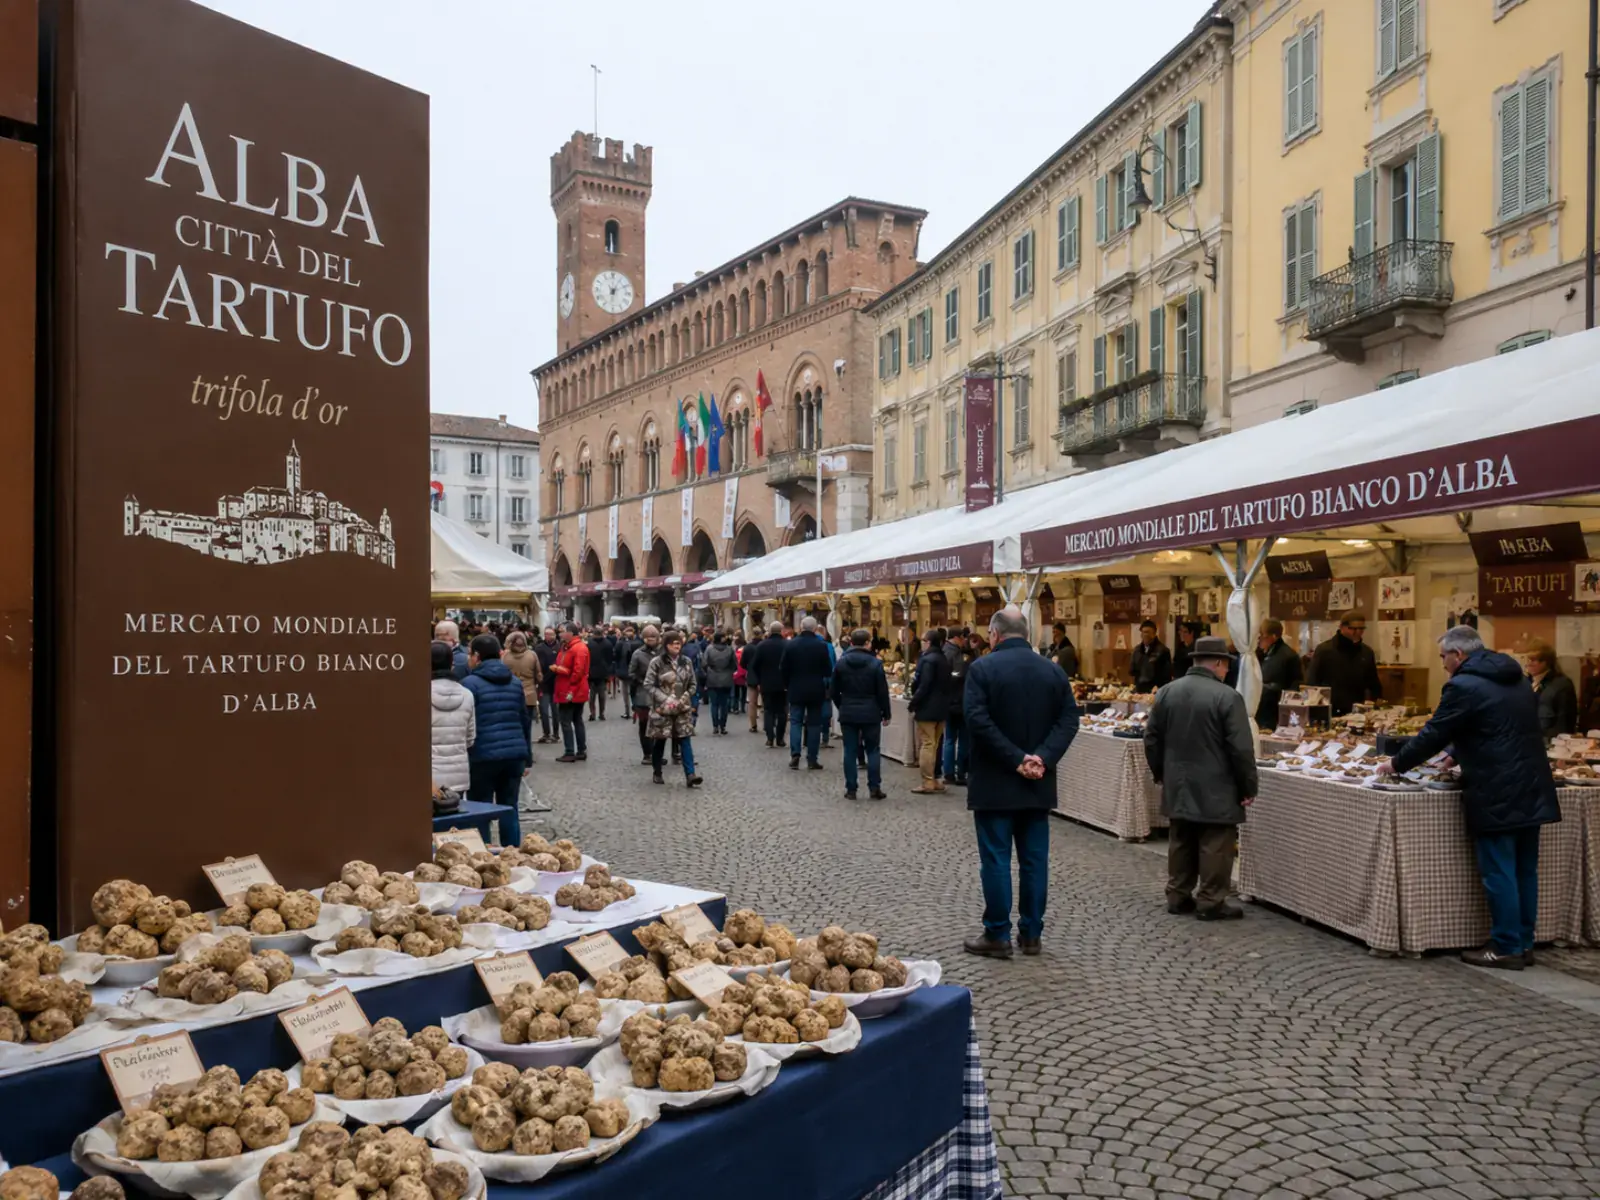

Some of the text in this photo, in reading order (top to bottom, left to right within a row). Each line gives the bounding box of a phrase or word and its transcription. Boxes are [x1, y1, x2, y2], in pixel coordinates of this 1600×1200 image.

[145, 102, 385, 247] ALBA
[174, 214, 361, 288] CITTÀ DEL
[105, 242, 412, 367] TARTUFO
[190, 374, 349, 426] trifola d'or
[1064, 453, 1519, 554] MERCATO MONDIALE DEL TARTUFO BIANCO D'ALBA
[124, 613, 397, 635] MERCATO MONDIALE
[112, 653, 405, 675] DEL TARTUFO BIANCO
[222, 692, 317, 714] D'ALBA
